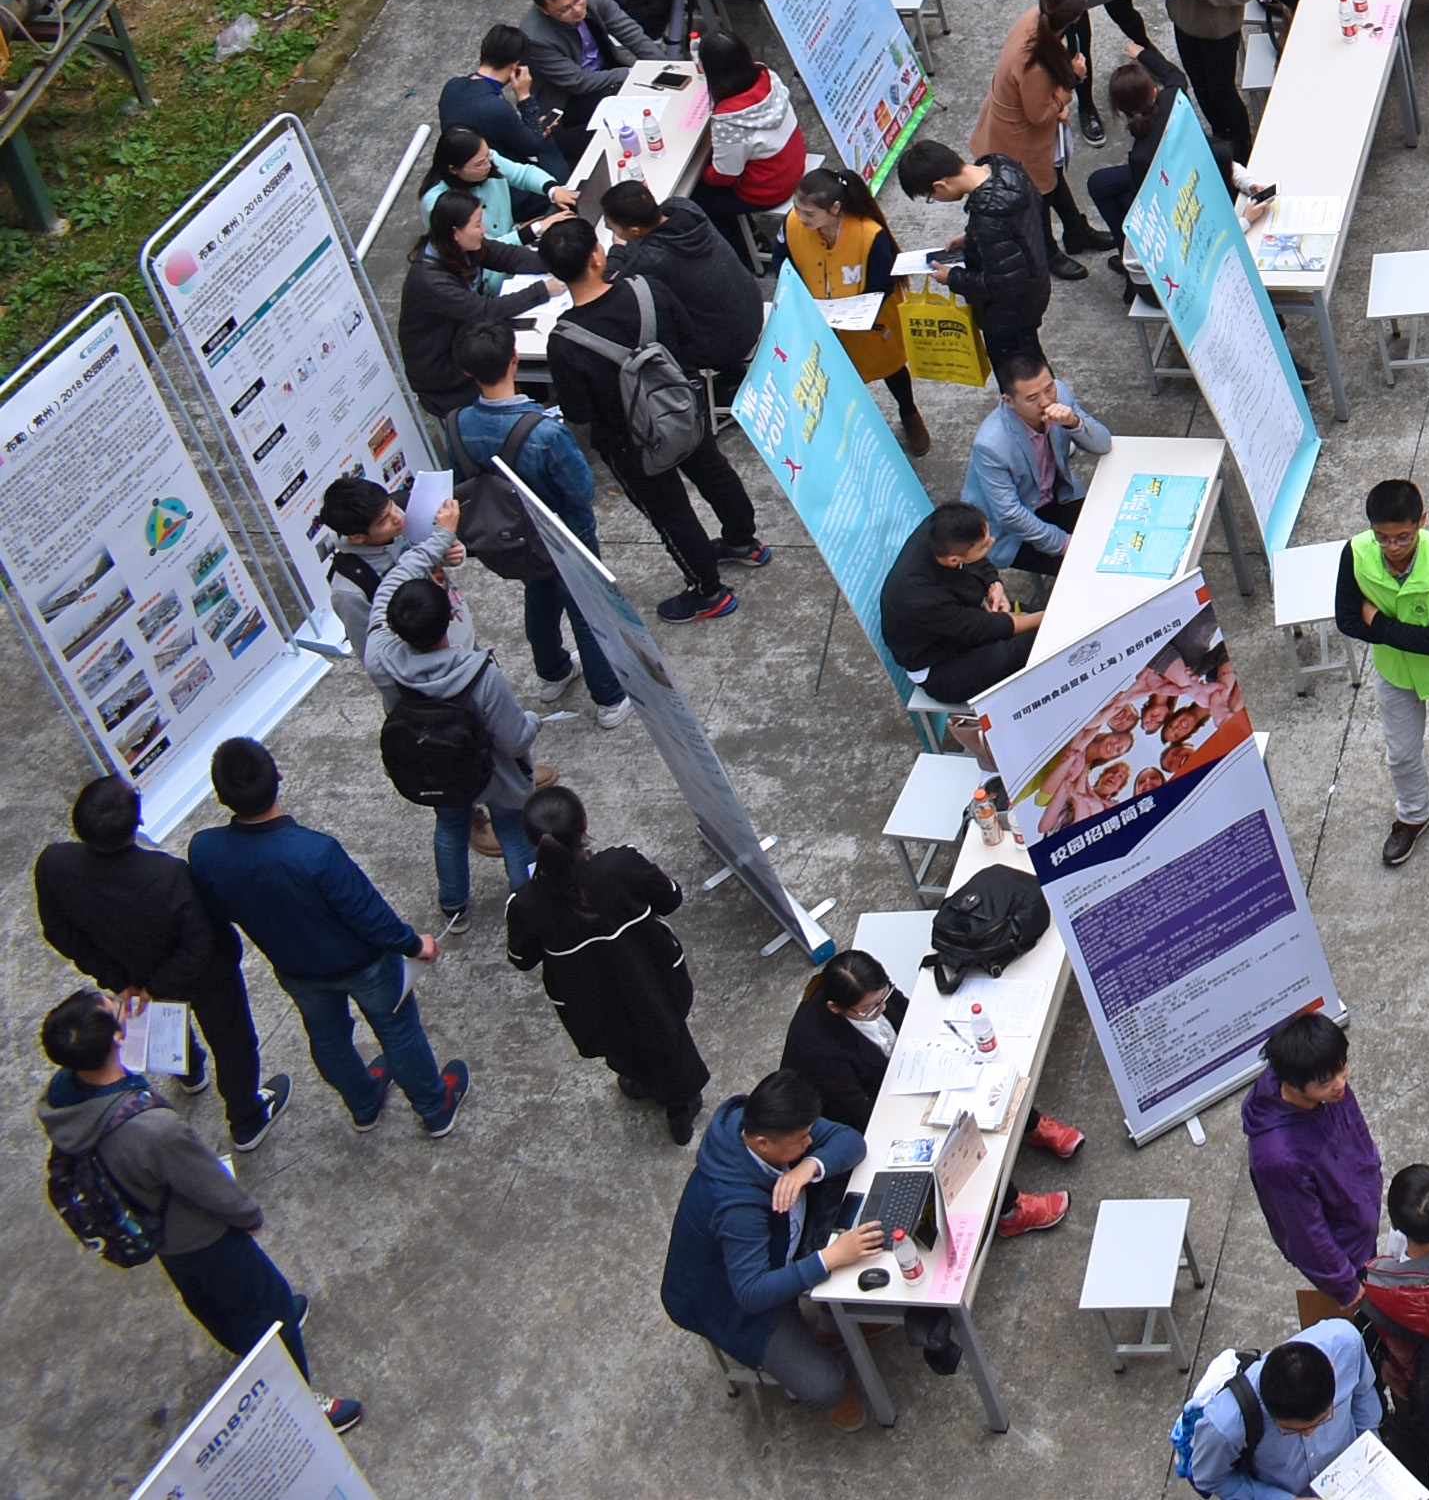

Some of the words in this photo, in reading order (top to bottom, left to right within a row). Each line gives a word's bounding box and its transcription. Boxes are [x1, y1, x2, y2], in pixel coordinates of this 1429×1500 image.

[243, 192, 264, 216] 2018
[260, 160, 294, 198] 校园招聘
[1136, 190, 1166, 262] WANT
[841, 264, 862, 286] M
[909, 318, 937, 328] 环球
[911, 329, 937, 338] 教育
[59, 378, 84, 403] 2018
[80, 342, 121, 384] 校园招聘
[738, 378, 761, 426] WE
[748, 369, 783, 446] WANT
[1048, 796, 1157, 867] 校园招聘简章
[194, 1376, 268, 1471] SINBON
